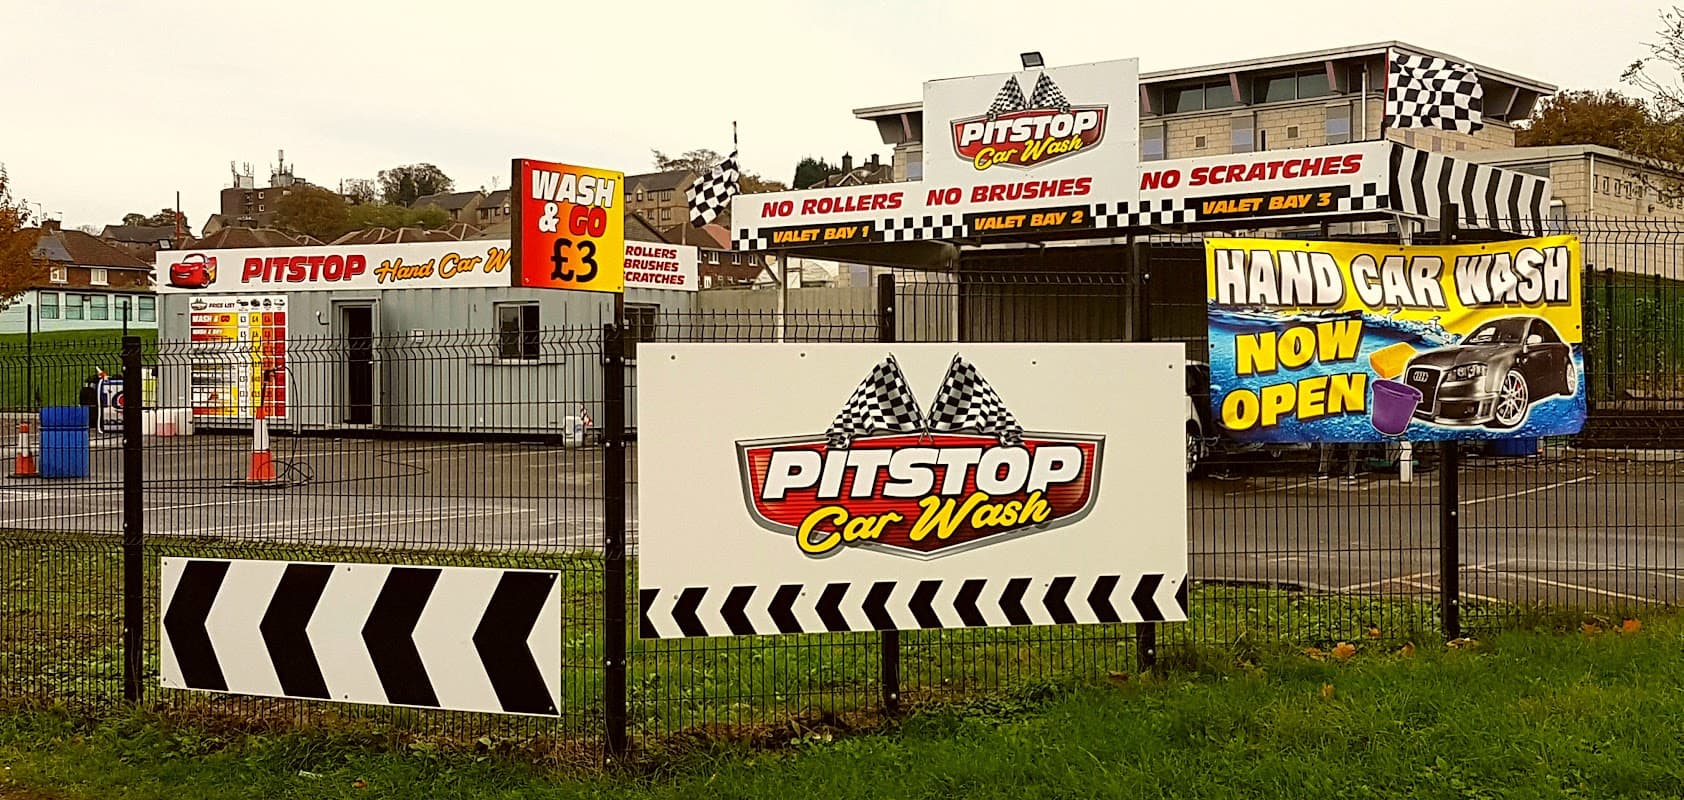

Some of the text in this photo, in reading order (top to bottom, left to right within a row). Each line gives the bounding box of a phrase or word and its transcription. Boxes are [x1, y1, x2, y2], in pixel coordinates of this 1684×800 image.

[960, 110, 1098, 147] PITSTOP
[973, 134, 1083, 170] Car Wash
[531, 169, 616, 208] WASH
[1140, 154, 1363, 191] NO SCRATCHES
[761, 192, 904, 218] NO ROLLERS
[926, 177, 1093, 206] NO BRUSHES
[1202, 192, 1332, 215] VALET BAY 3
[538, 202, 608, 238] & GO
[773, 225, 870, 244] VALET BAY 1
[974, 210, 1084, 231] VALET BAY 2
[241, 254, 367, 284] PITSTOP
[374, 257, 434, 284] Hand
[438, 252, 483, 279] Car
[550, 237, 599, 283] £3
[624, 258, 680, 273] BRUSHES
[625, 245, 678, 260] ROLLERS
[623, 271, 686, 286] CRATCHES
[1214, 246, 1569, 308] HAND CAR WASH
[1236, 319, 1364, 376] NOW
[1221, 373, 1367, 431] OPEN
[762, 445, 1084, 499] PITSTOP
[796, 490, 1052, 554] Car Wash
